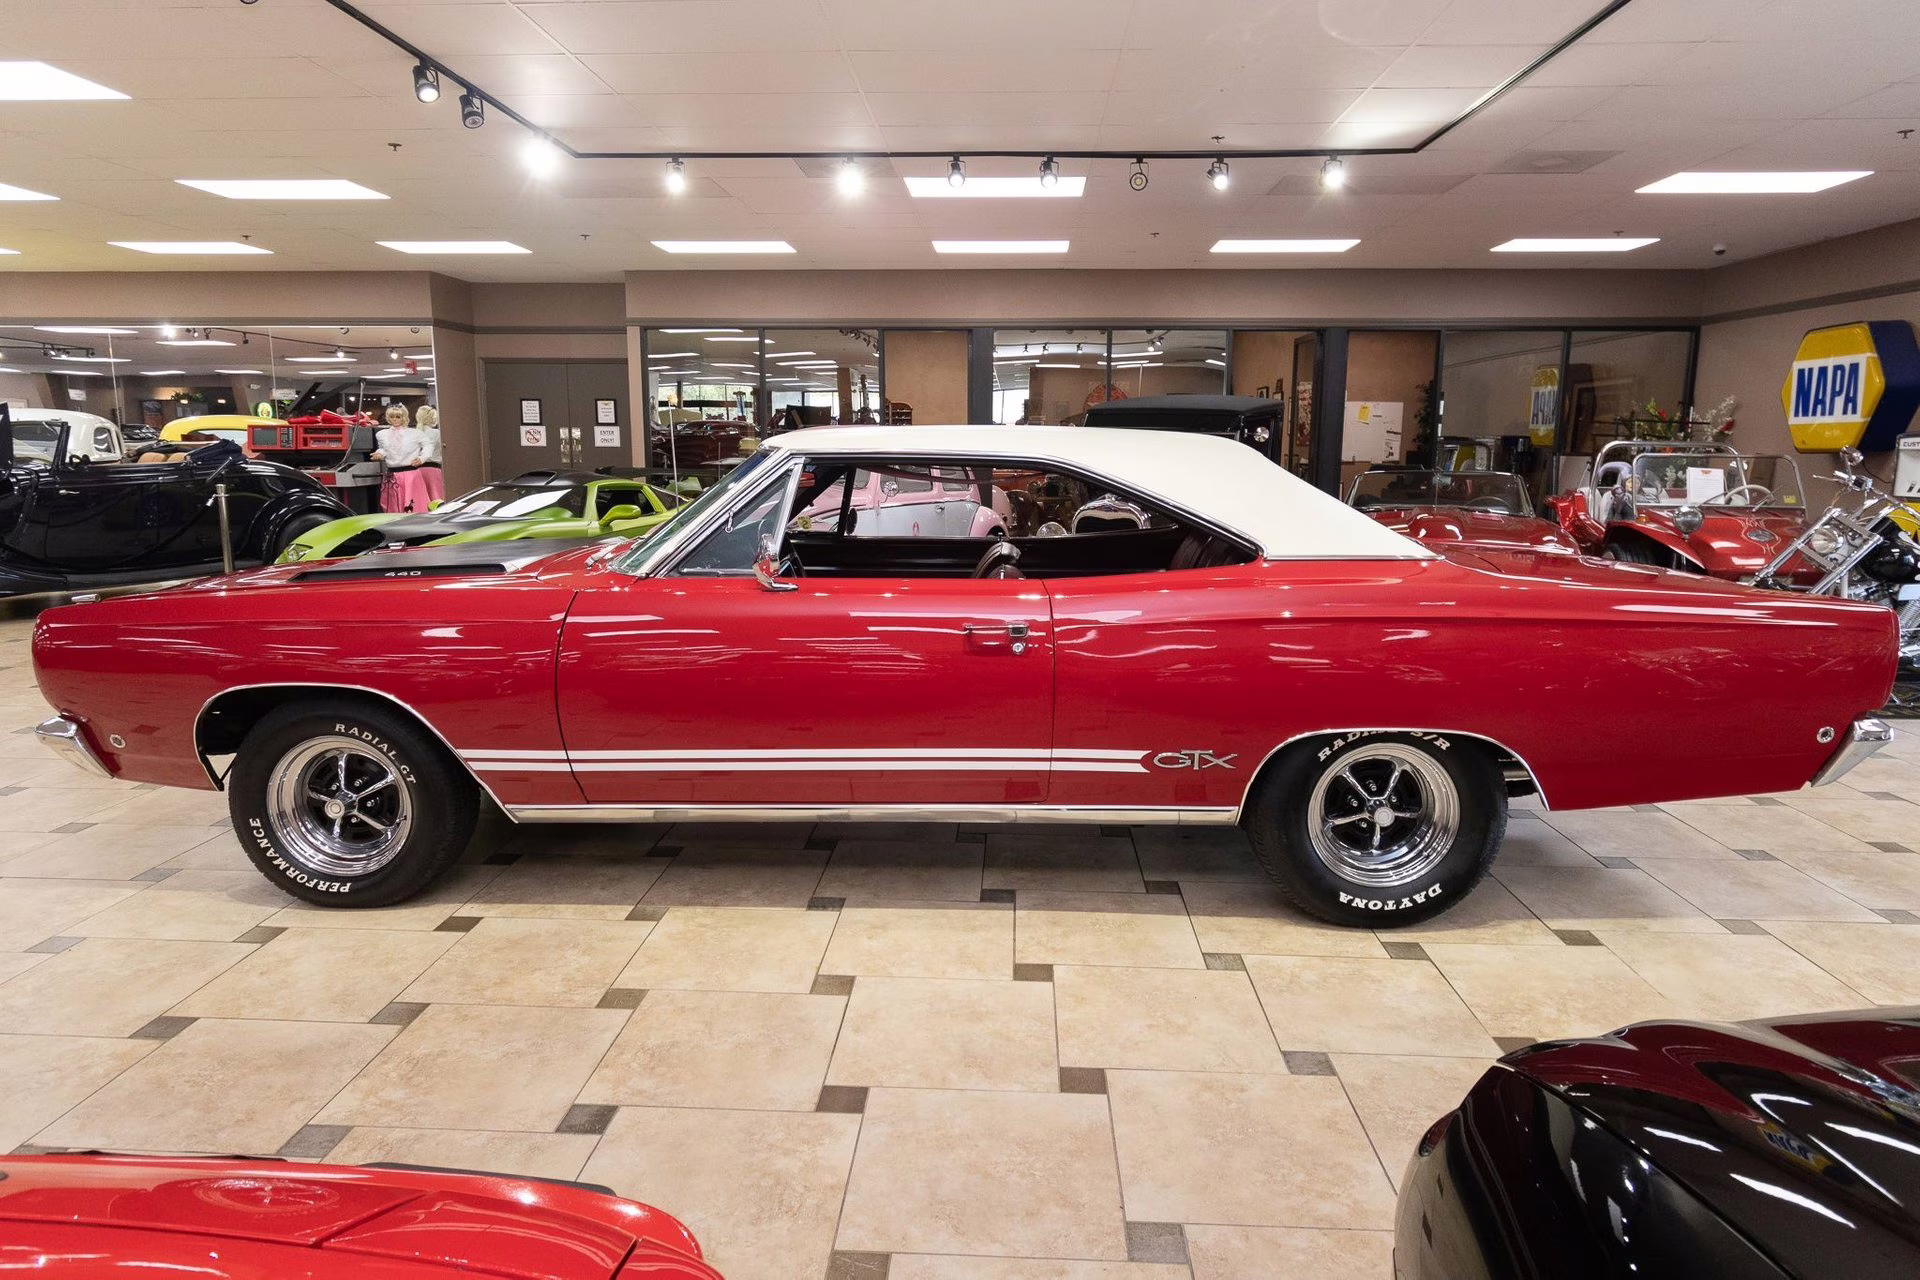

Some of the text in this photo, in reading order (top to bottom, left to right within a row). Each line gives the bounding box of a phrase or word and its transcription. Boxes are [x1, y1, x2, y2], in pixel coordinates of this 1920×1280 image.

[1794, 363, 1859, 417] NAPA
[335, 723, 417, 785] RADIAL GT
[1153, 749, 1238, 771] GTX
[248, 817, 353, 893] PERFORMANCE
[1339, 883, 1443, 911] DAYTONA
